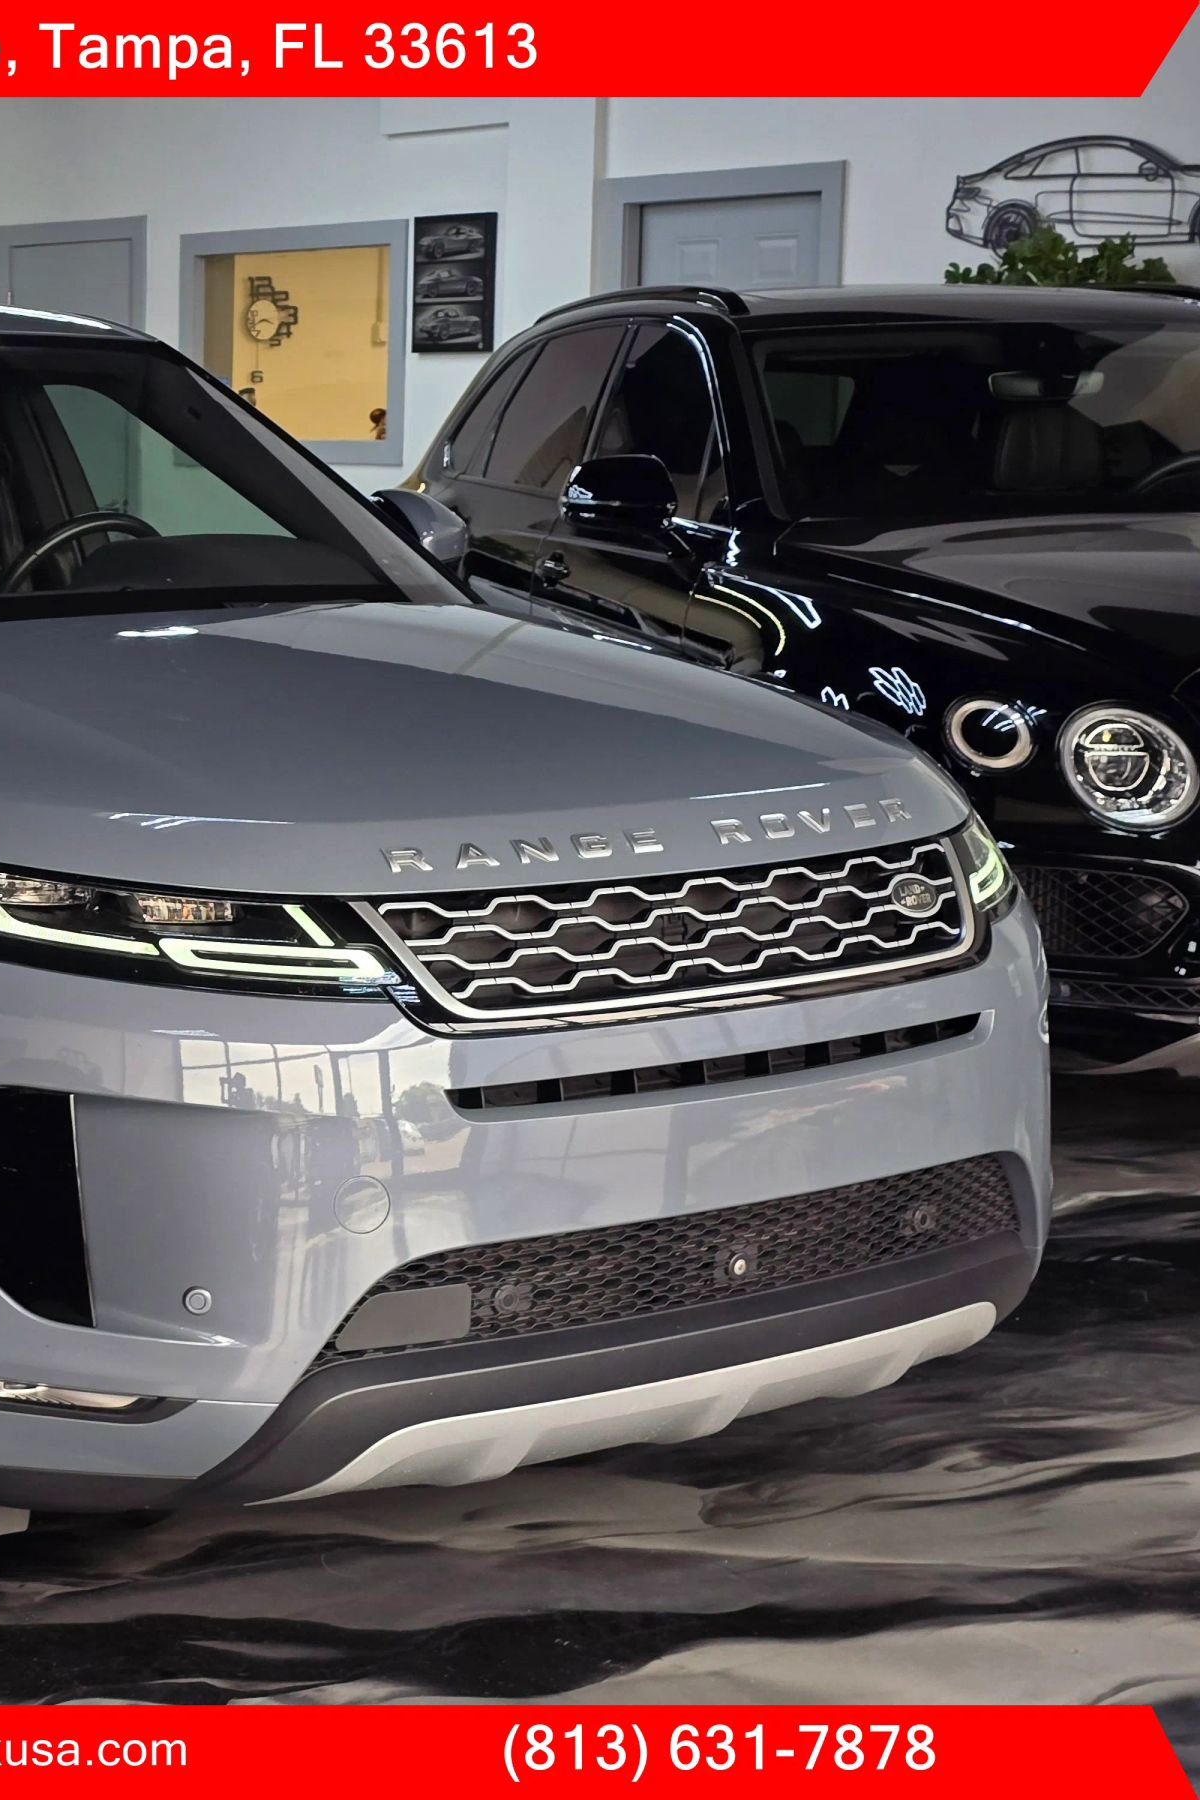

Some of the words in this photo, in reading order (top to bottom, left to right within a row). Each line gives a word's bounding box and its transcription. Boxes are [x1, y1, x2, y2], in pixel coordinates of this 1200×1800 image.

[380, 827, 664, 873] RANGE
[710, 798, 913, 845] ROVER
[898, 883, 922, 897] LAND
[905, 892, 932, 907] ROVER
